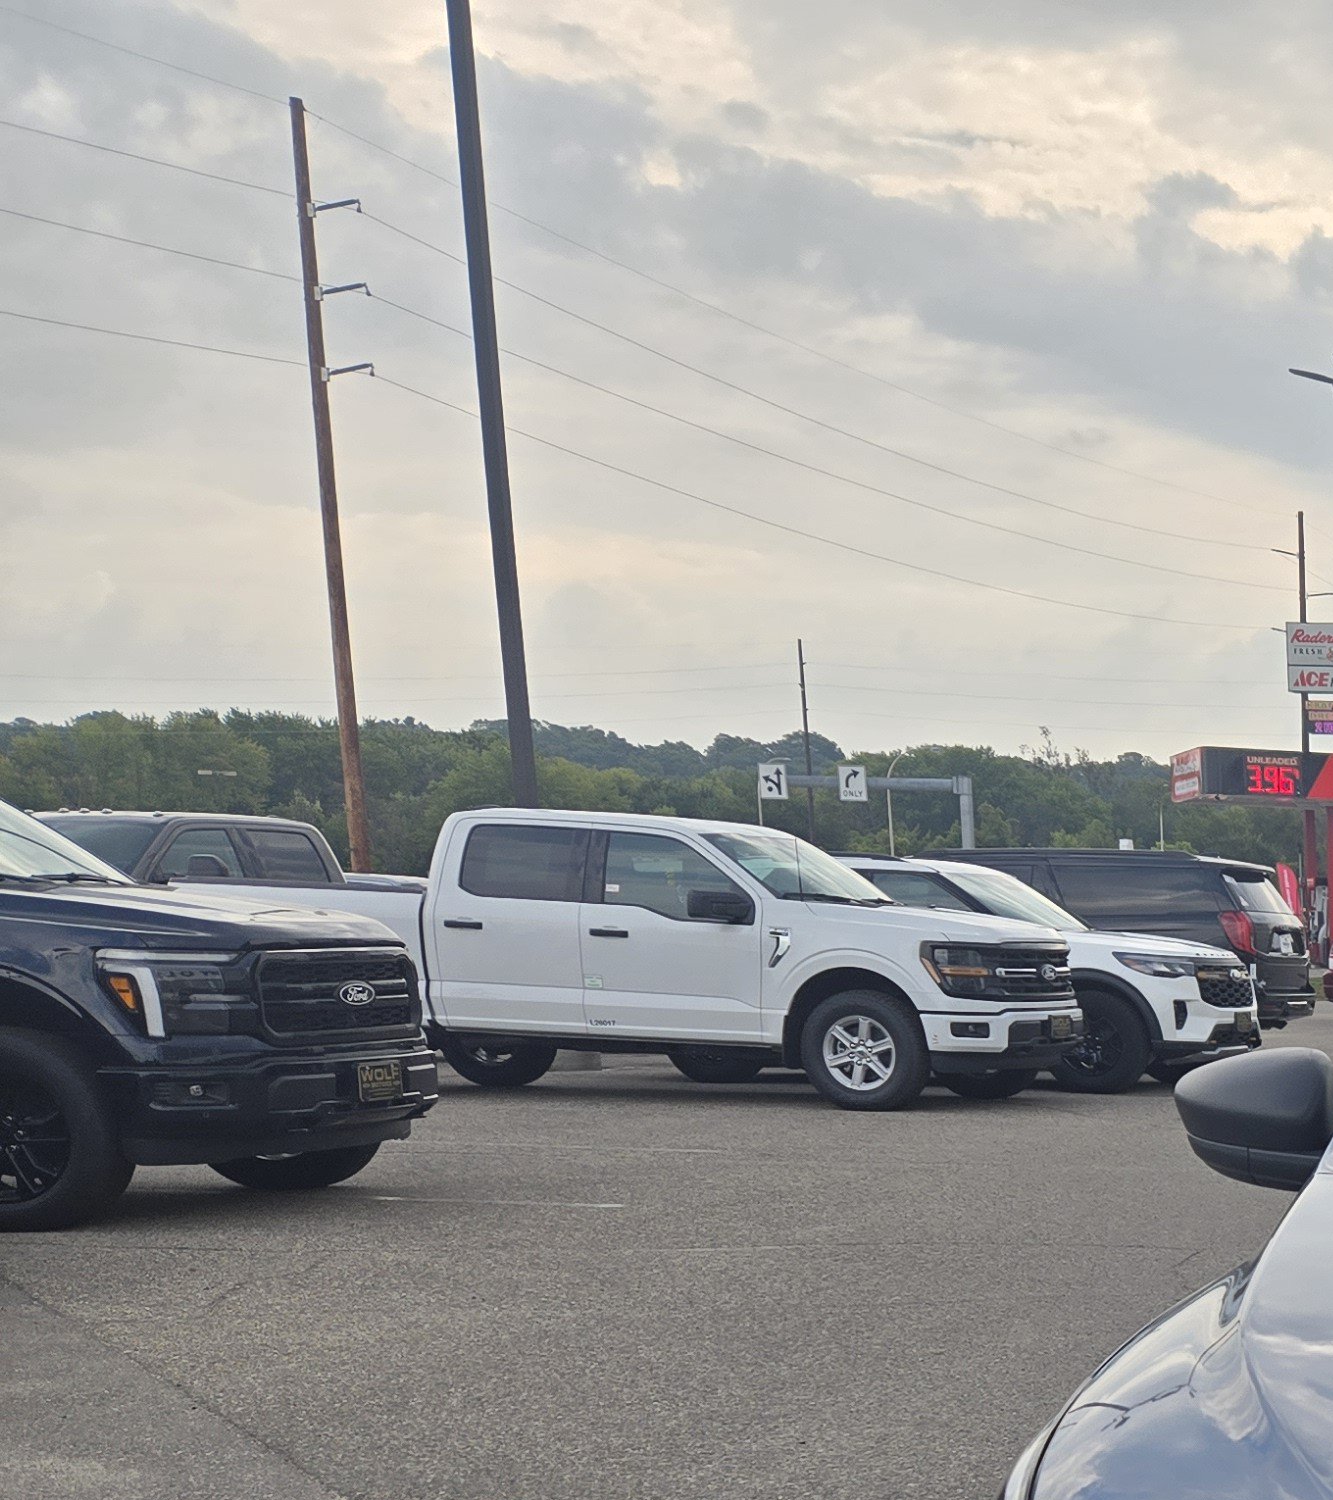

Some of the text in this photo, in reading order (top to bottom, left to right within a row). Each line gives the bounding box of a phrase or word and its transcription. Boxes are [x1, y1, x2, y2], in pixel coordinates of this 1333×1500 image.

[1293, 670, 1330, 687] ACE
[1246, 755, 1298, 766] UNLEADED
[842, 789, 863, 797] ONLY
[361, 1066, 399, 1081] WOLF
